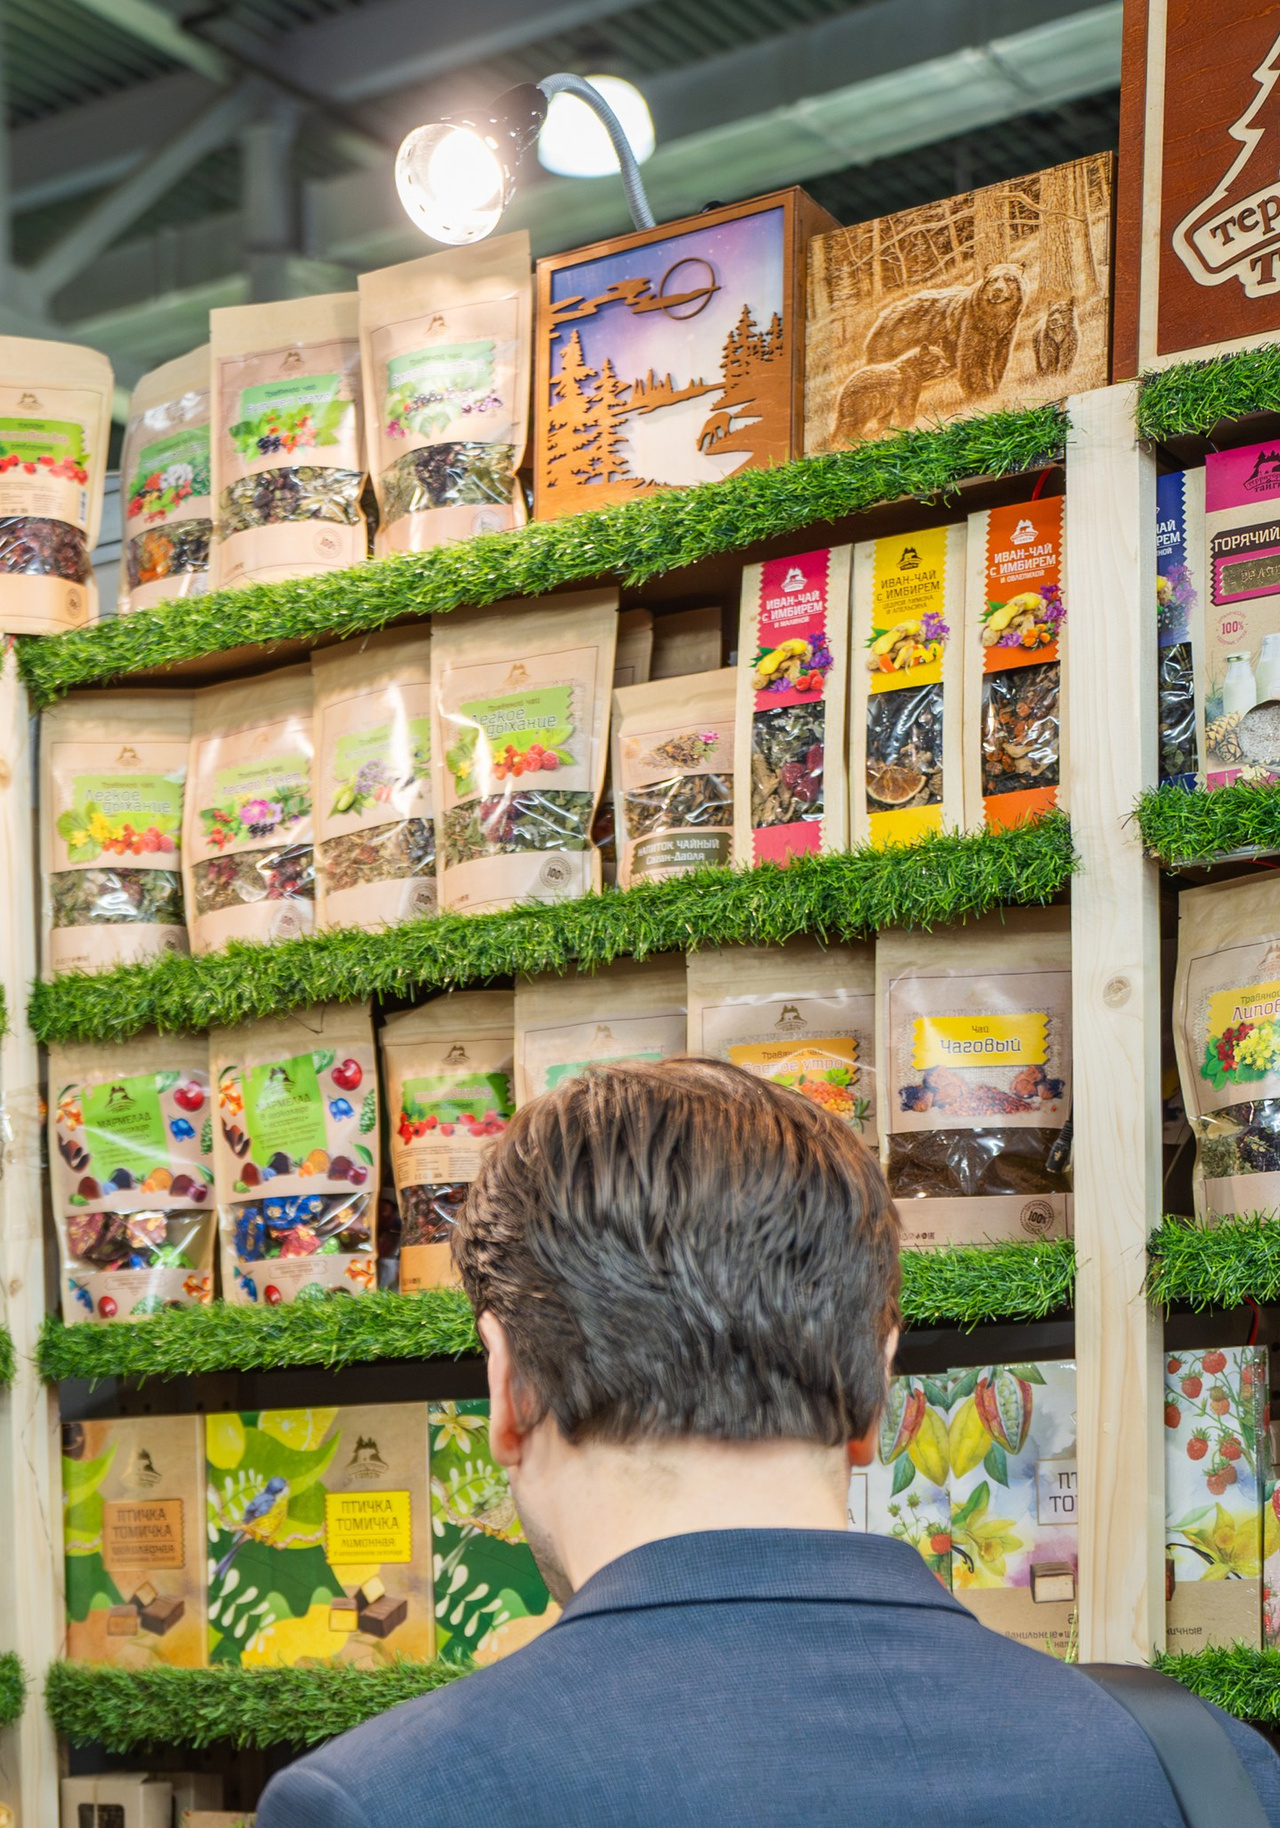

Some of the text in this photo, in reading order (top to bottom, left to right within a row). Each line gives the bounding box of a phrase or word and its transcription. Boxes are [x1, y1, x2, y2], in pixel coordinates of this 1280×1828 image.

[1214, 526, 1280, 552] ГОРЯЧИЙ
[994, 543, 1053, 563] ИВАН-ЧАЙ
[1000, 555, 1057, 575] ИМБИРЕМ
[881, 571, 937, 589] ИВАН-ЧАЙ
[883, 581, 940, 599] ИМБИРЕМ
[766, 590, 820, 610] ИВАН-ЧАЙ
[769, 601, 824, 620] ИМБИРЕМ
[1221, 620, 1243, 635] 100%
[486, 714, 557, 738] дыхание
[266, 771, 301, 787] букет
[85, 789, 142, 804] Легкое
[103, 800, 171, 818] дыхание
[676, 838, 720, 850] ЧАЙНЫЙ
[940, 1037, 1022, 1054] Чаговый
[803, 1058, 843, 1073] утро
[256, 1093, 312, 1109] МАРМЕЛАД
[97, 1111, 152, 1128] МАРМЕЛАД
[118, 1507, 167, 1523] ПТИЧКА
[341, 1499, 393, 1514] ПТИЧКА
[112, 1524, 173, 1539] ТОМИЧКА
[335, 1517, 400, 1532] ТОМИЧКА
